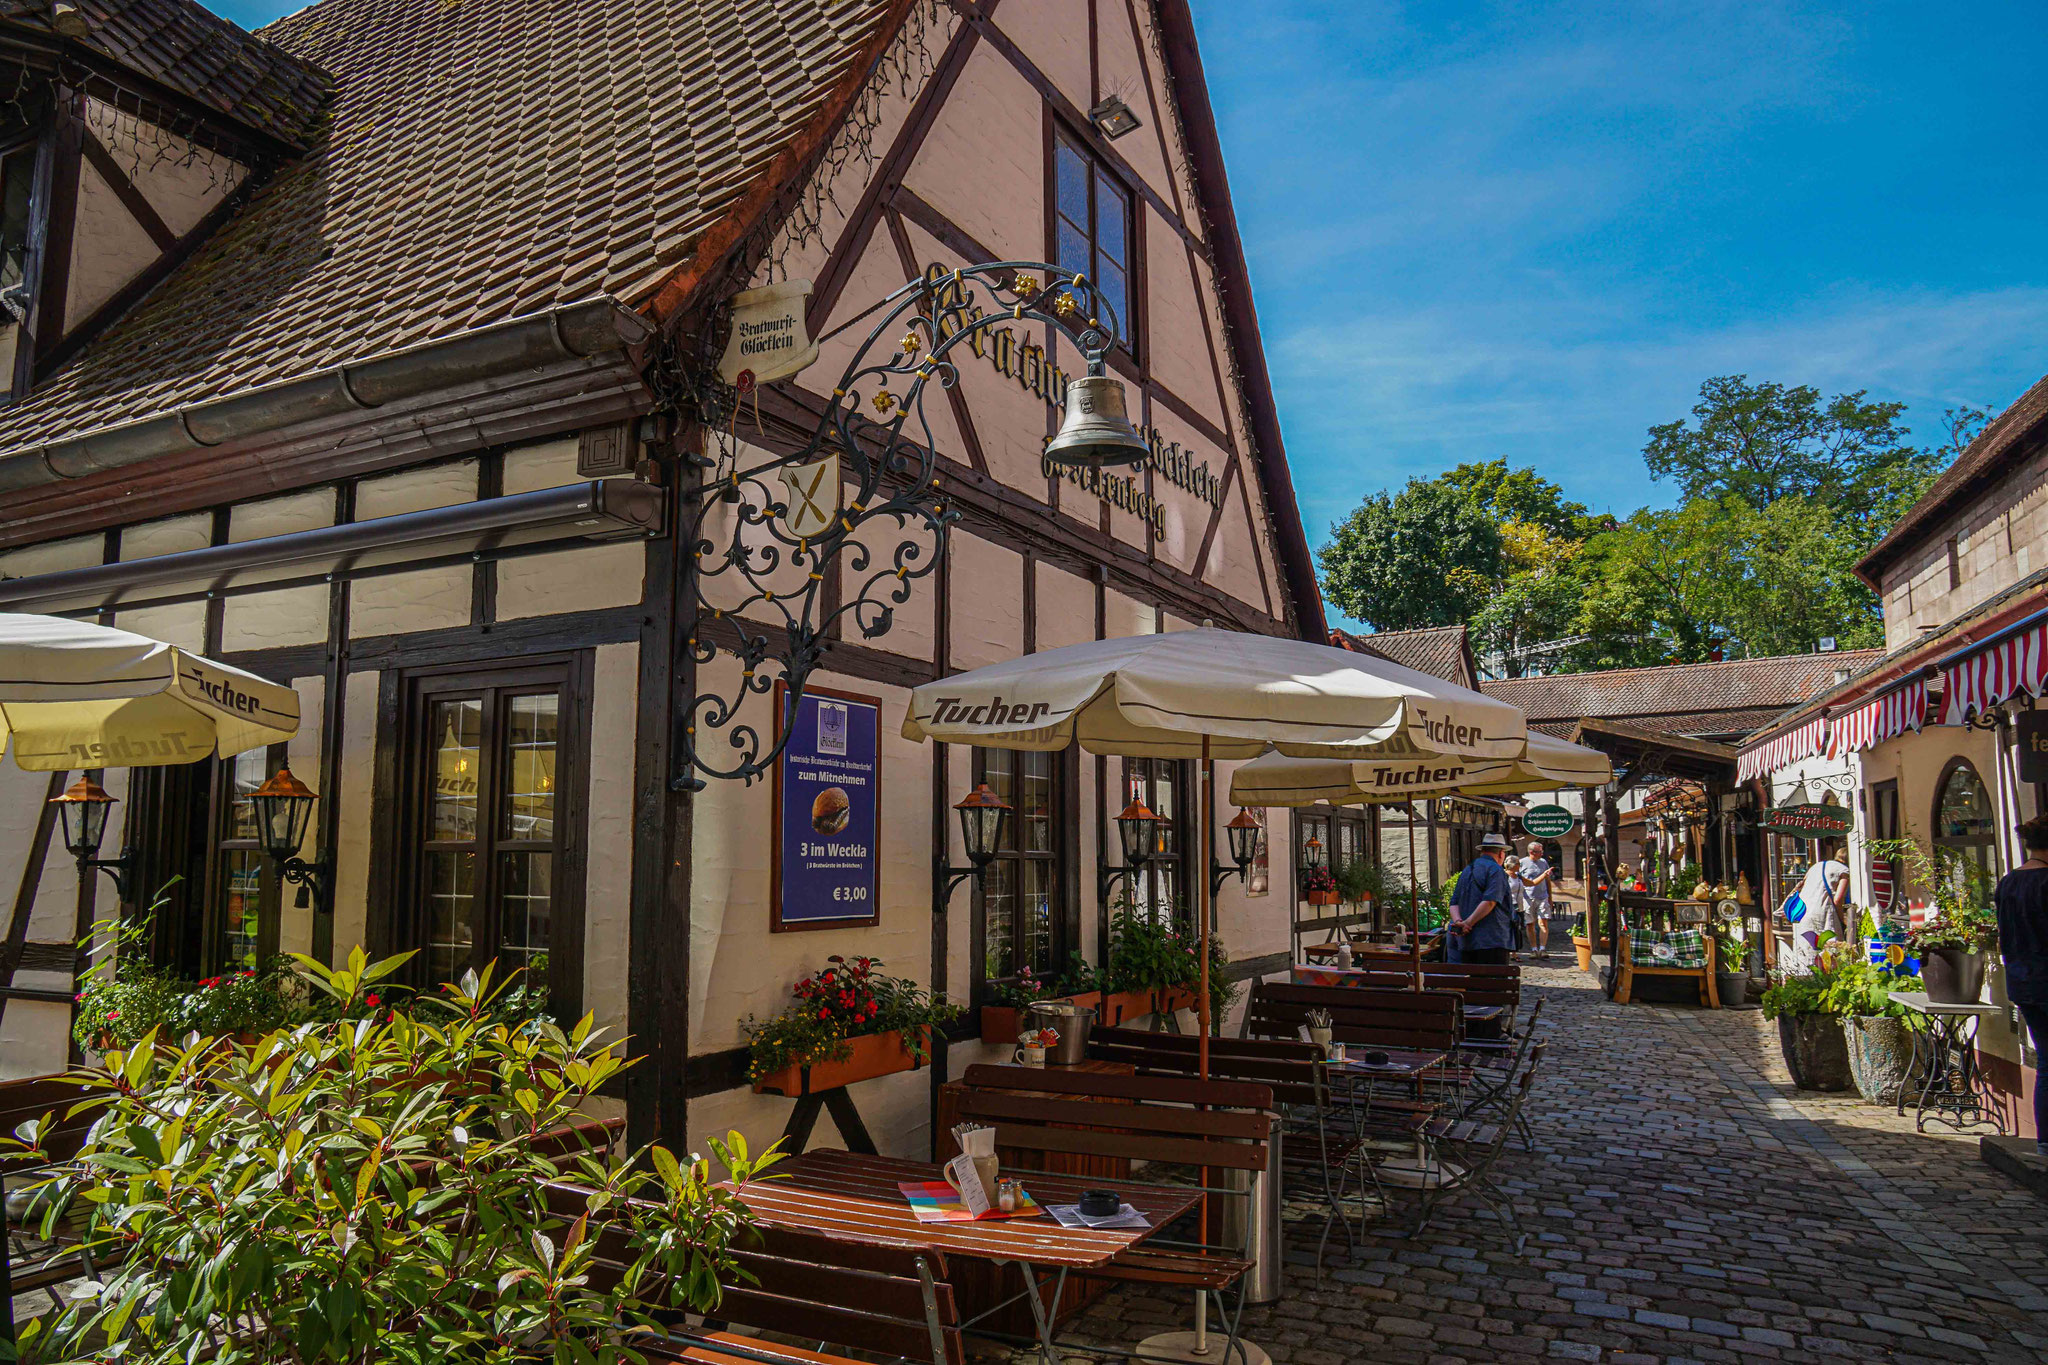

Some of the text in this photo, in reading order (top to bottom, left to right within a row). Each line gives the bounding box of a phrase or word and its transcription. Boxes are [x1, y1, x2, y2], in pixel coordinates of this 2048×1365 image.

[740, 332, 793, 356] Glöcklein
[930, 697, 1050, 726] Tucher
[1416, 708, 1482, 748] Tucher
[798, 771, 866, 786] zum Mitnehmen
[1372, 765, 1465, 787] Tucher
[800, 843, 867, 858] 3 im Weckla
[843, 886, 867, 902] 3,00
